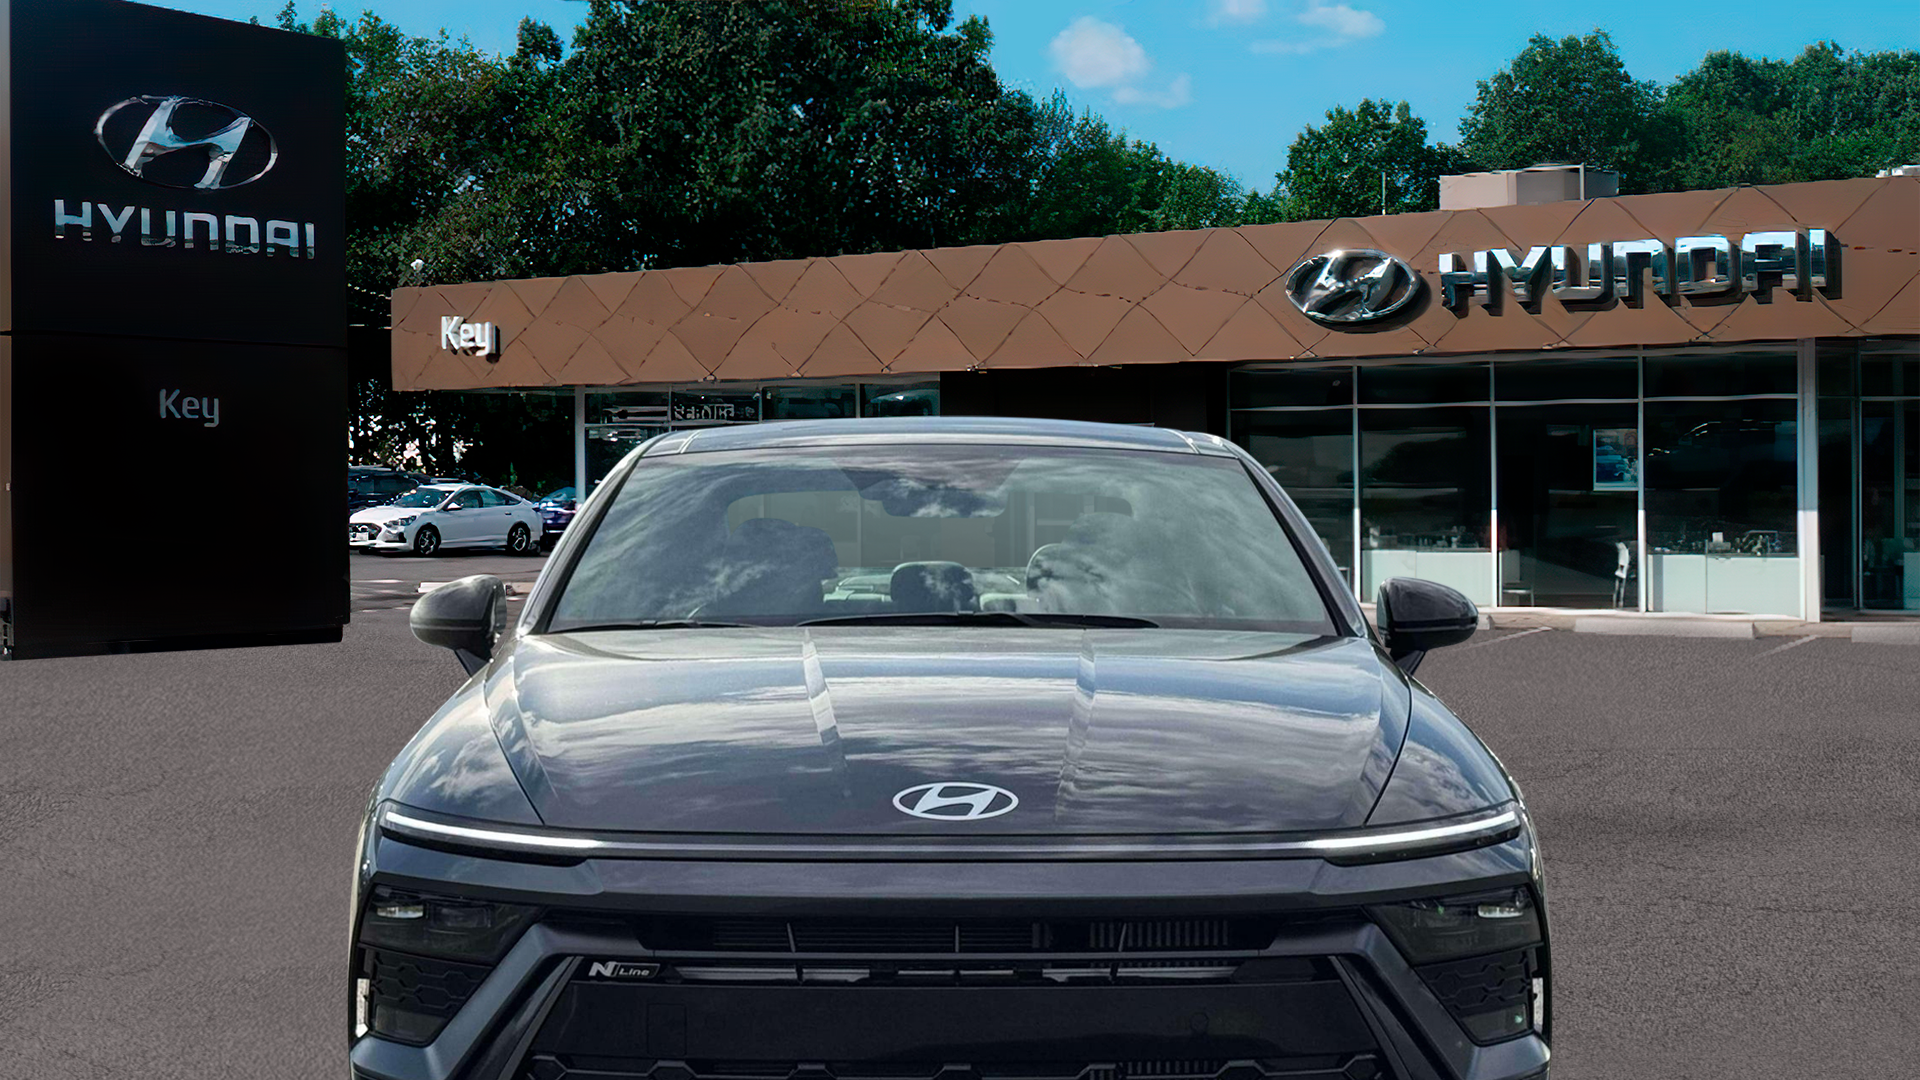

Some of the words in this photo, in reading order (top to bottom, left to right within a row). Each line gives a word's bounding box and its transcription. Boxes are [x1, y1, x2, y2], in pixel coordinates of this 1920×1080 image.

[54, 199, 315, 259] HYUNDAI
[1438, 228, 1838, 312] HYUNDAI
[441, 315, 493, 357] Key
[159, 388, 220, 427] Key
[588, 961, 617, 977] N
[618, 967, 650, 976] Line
